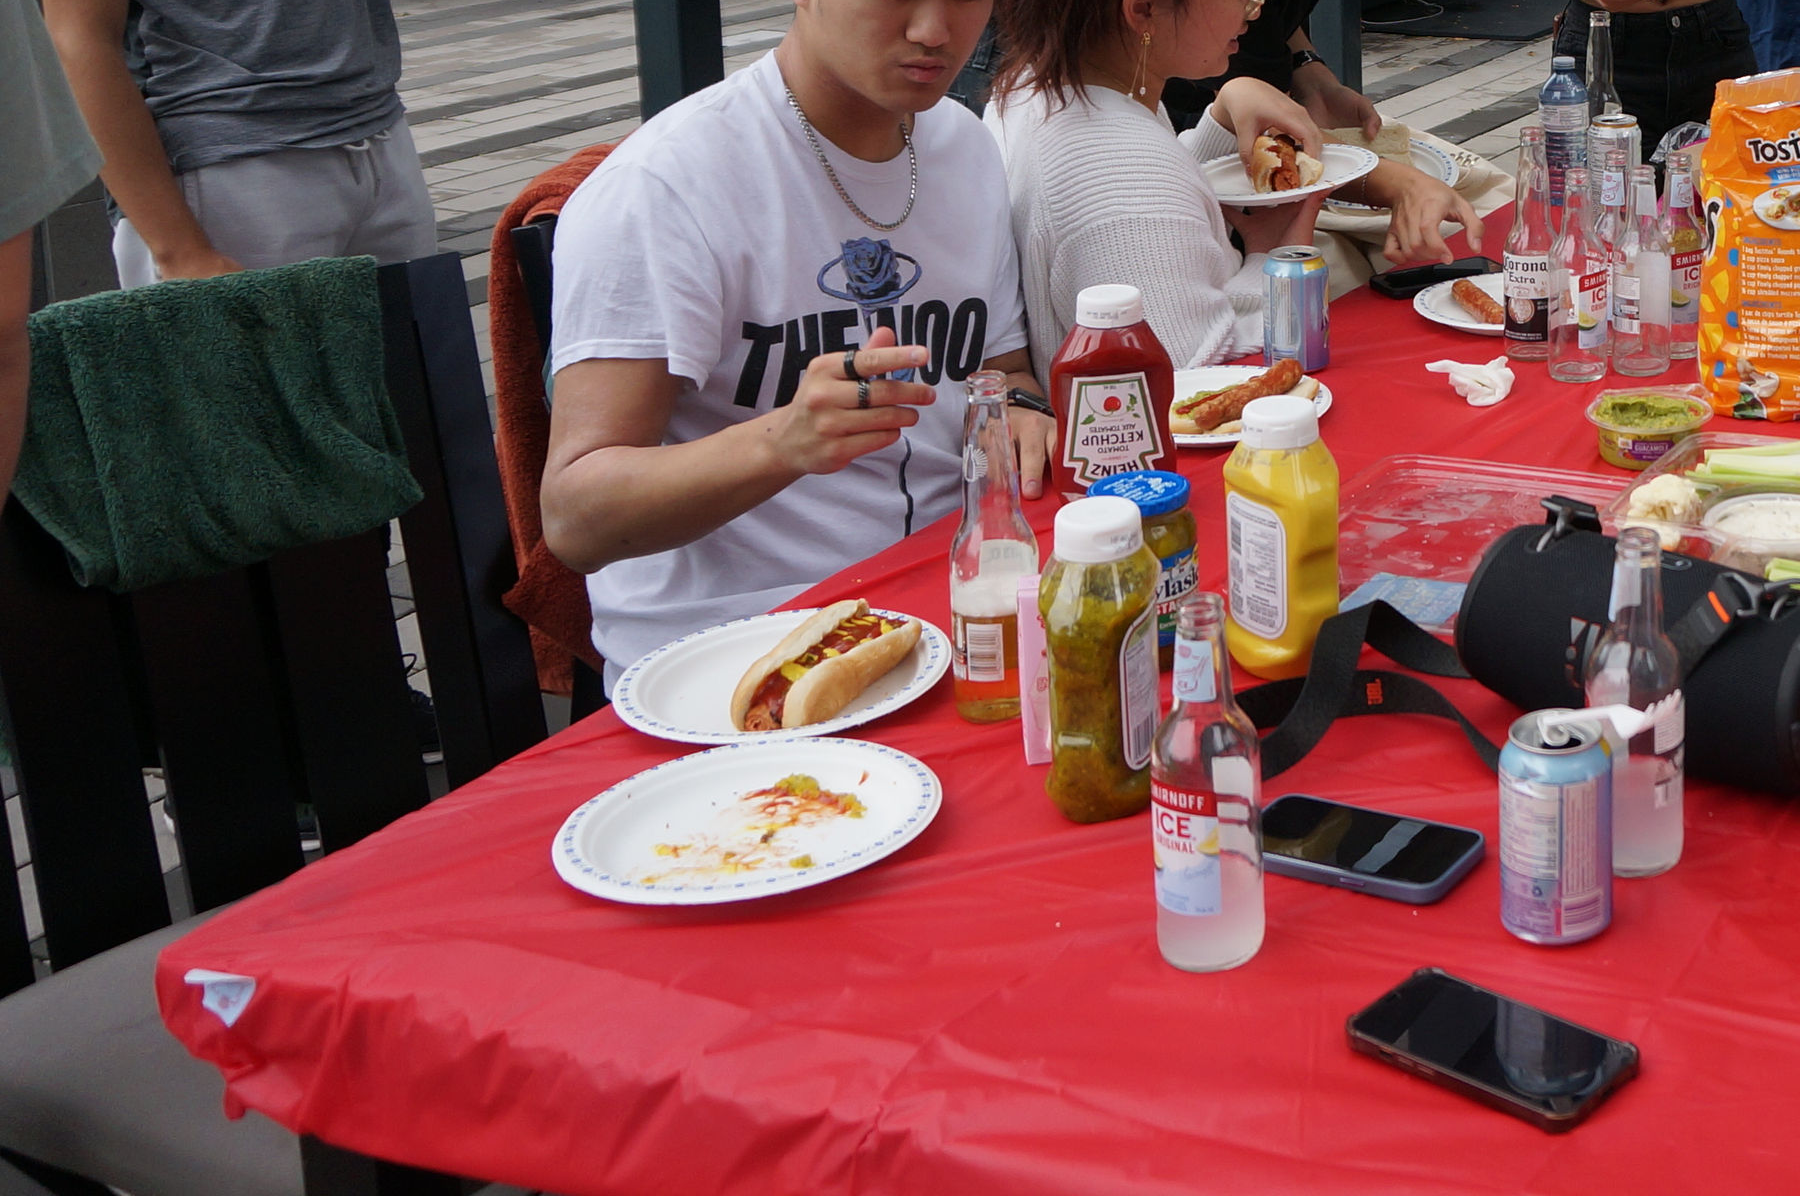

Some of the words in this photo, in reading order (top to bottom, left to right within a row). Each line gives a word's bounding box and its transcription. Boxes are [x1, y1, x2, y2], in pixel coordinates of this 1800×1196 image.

[1504, 255, 1548, 272] Corona
[1676, 252, 1702, 266] SMIRN
[1509, 272, 1535, 284] Extra
[733, 308, 860, 409] THE
[1088, 424, 1120, 434] TOMATES
[1081, 430, 1144, 446] KETCHUP
[1097, 445, 1129, 454] TOMATO
[1090, 460, 1139, 476] HEINZ
[1155, 567, 1198, 599] Vlasi
[1152, 784, 1205, 811] MIRNOFF
[1156, 806, 1191, 838] ICE
